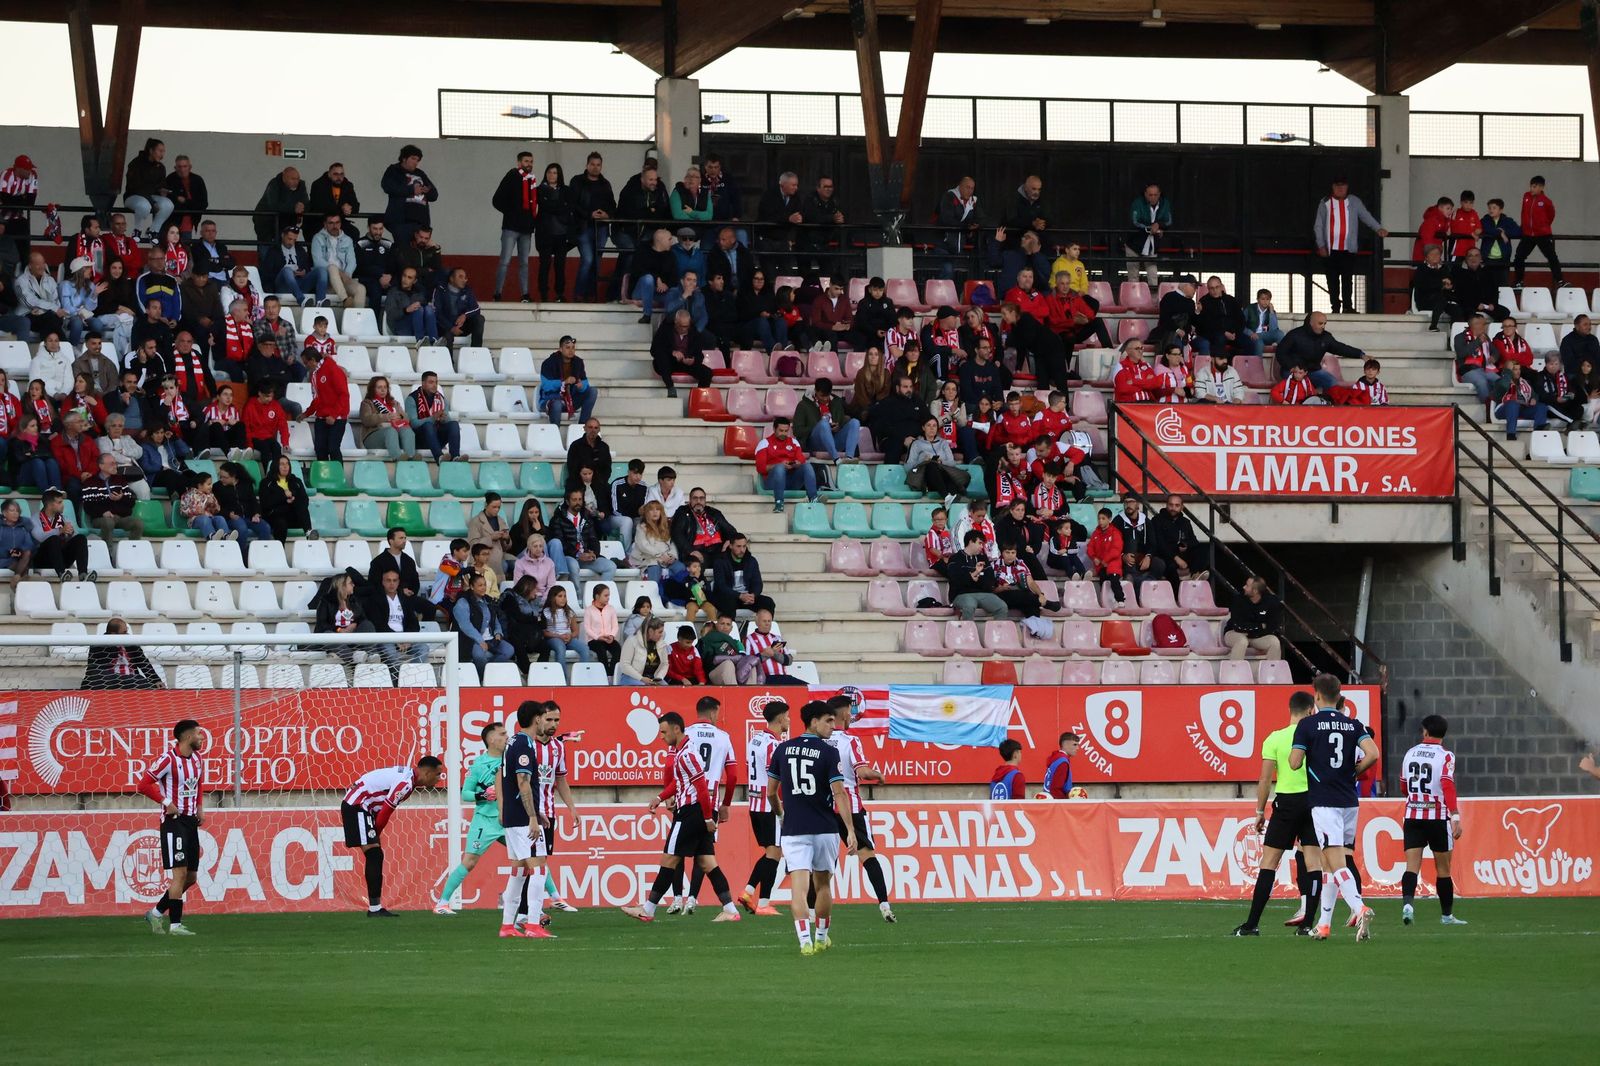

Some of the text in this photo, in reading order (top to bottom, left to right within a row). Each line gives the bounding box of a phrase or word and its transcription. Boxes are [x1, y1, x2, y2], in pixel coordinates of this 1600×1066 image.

[1215, 450, 1417, 494] TAMAR, S.A.
[1104, 699, 1130, 746] 8
[1218, 699, 1244, 745] 8
[1317, 722, 1331, 731] JON
[224, 725, 362, 755] OPTICO
[1185, 722, 1227, 776] ZAMORA
[1328, 732, 1344, 769] 3
[699, 742, 712, 773] 9
[750, 750, 757, 780] 3
[866, 759, 952, 777] AMIENTO
[593, 769, 643, 781] PODOLOGÍA
[646, 771, 651, 780] Y
[787, 757, 817, 796] 15
[1408, 761, 1433, 795] 22
[176, 837, 182, 850] 8
[477, 828, 483, 839] 1
[270, 826, 354, 900] CF
[1050, 870, 1101, 896] S.L.
